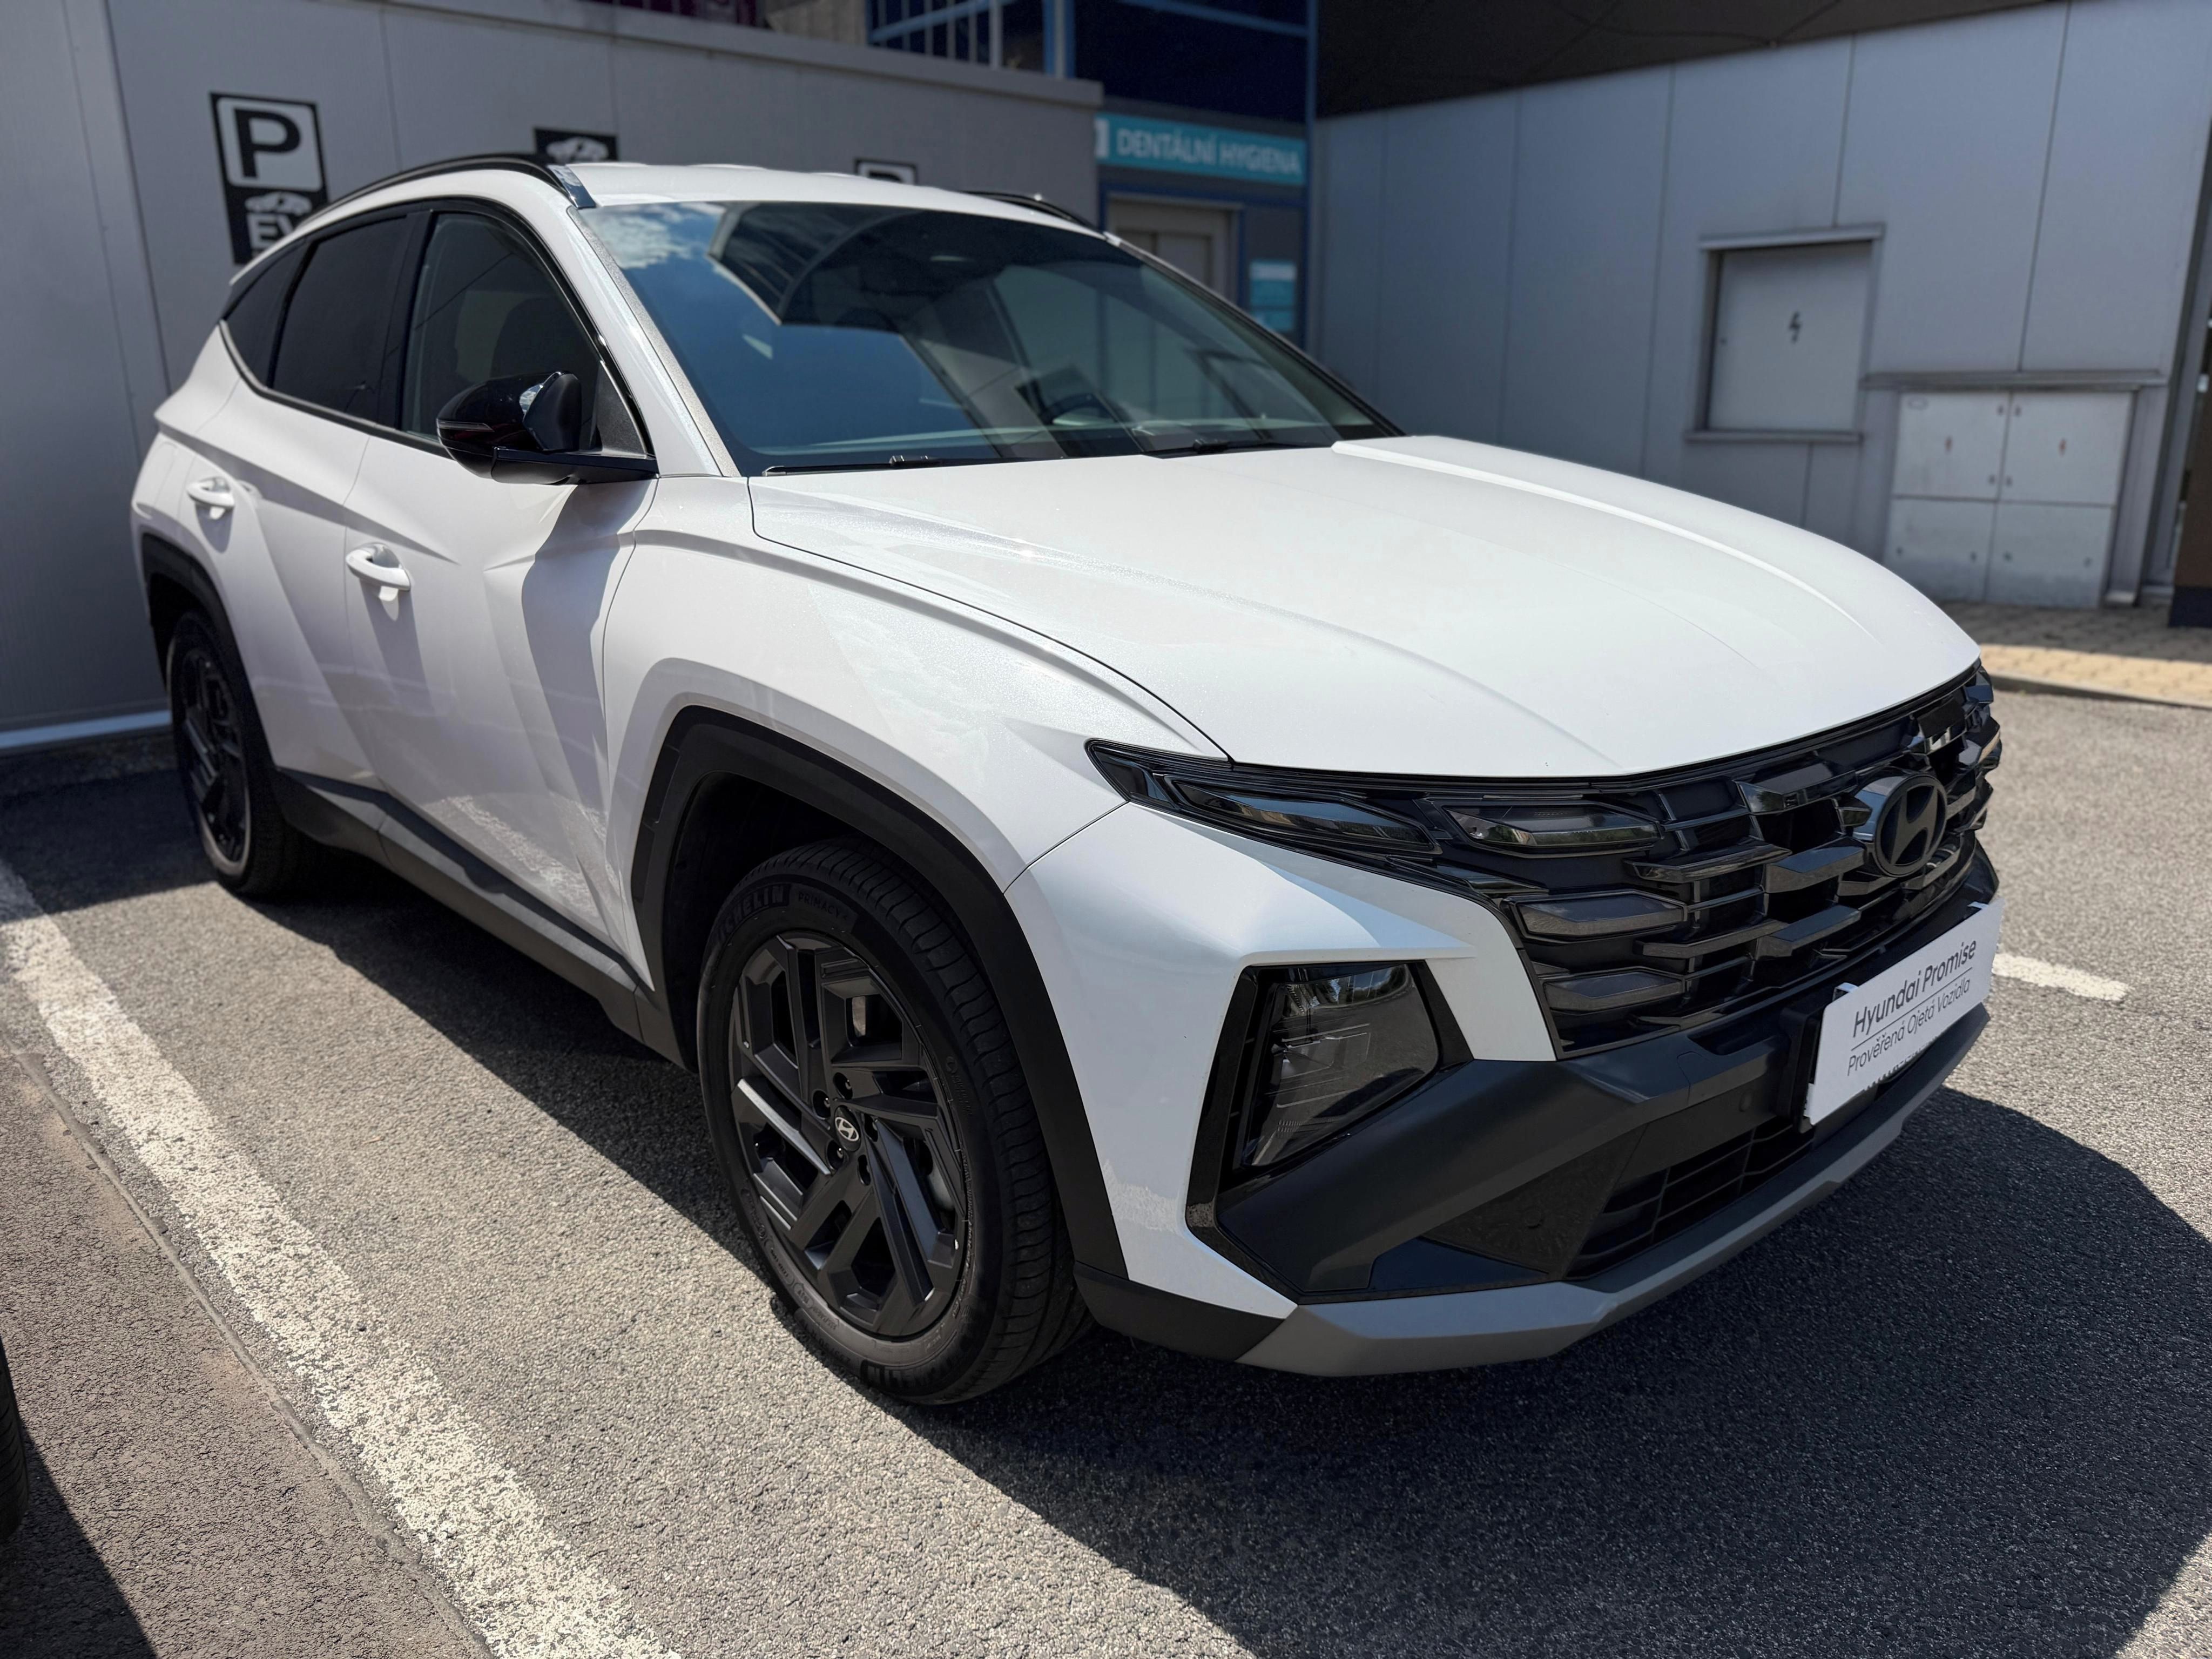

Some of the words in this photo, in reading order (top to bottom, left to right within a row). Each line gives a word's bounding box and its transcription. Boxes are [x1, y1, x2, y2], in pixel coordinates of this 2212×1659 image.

[232, 106, 302, 179] P
[1219, 142, 1302, 175] HYGIENA
[1847, 1020, 1905, 1076] Prověřená
[1907, 999, 1935, 1035] Ojetá
[1937, 977, 1970, 1013] Vozidla
[1853, 970, 1921, 1038] Hyundai
[1922, 940, 1977, 992] Promise
